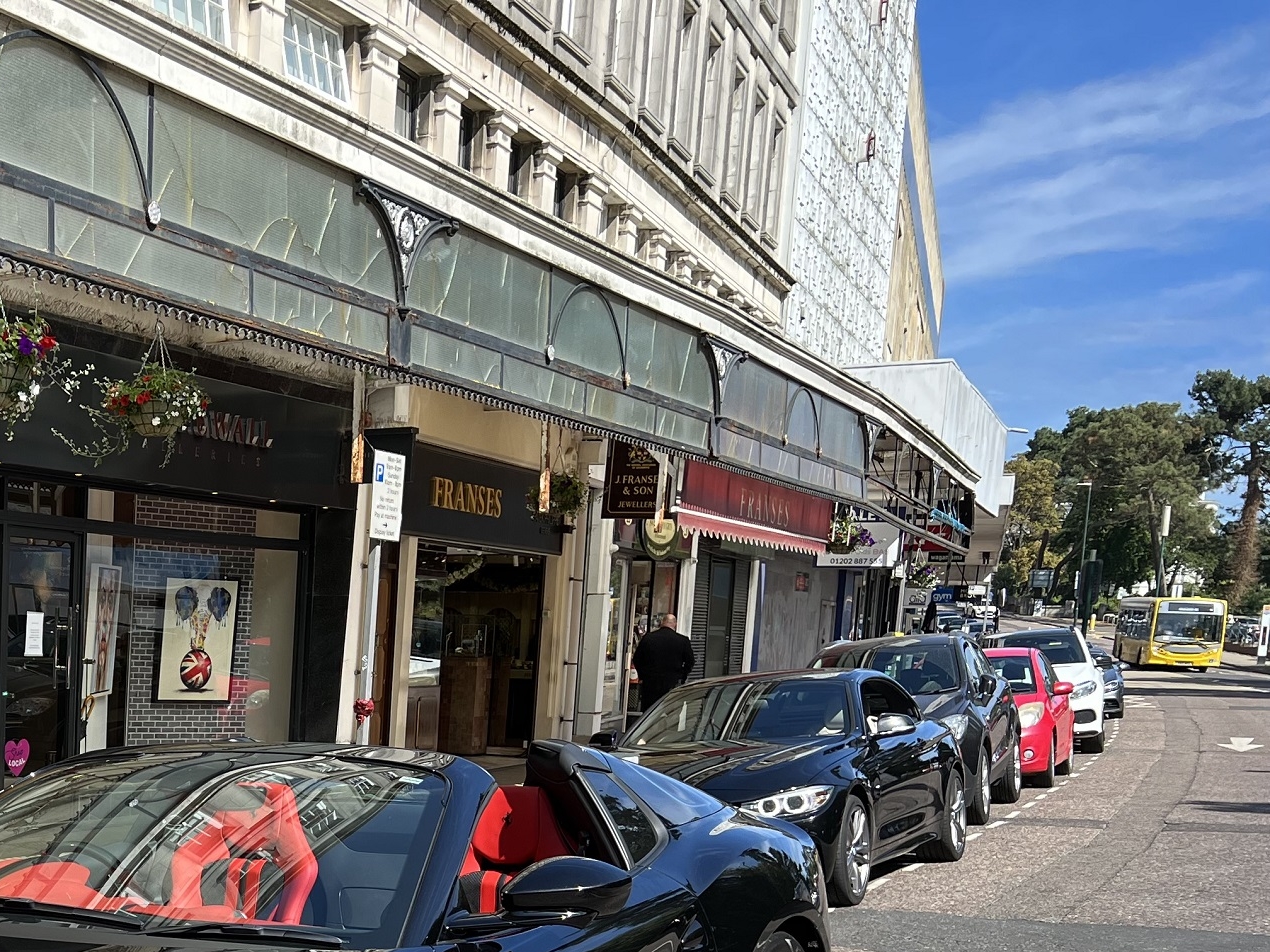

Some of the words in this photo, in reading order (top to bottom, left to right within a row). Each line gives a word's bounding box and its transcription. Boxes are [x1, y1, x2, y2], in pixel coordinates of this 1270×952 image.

[623, 486, 630, 495] &
[633, 486, 654, 495] SON
[432, 476, 503, 518] FRANSES
[739, 487, 790, 527] FRANSES
[830, 558, 853, 566] 01202
[933, 593, 952, 602] gym
[8, 758, 25, 767] LOCAL
